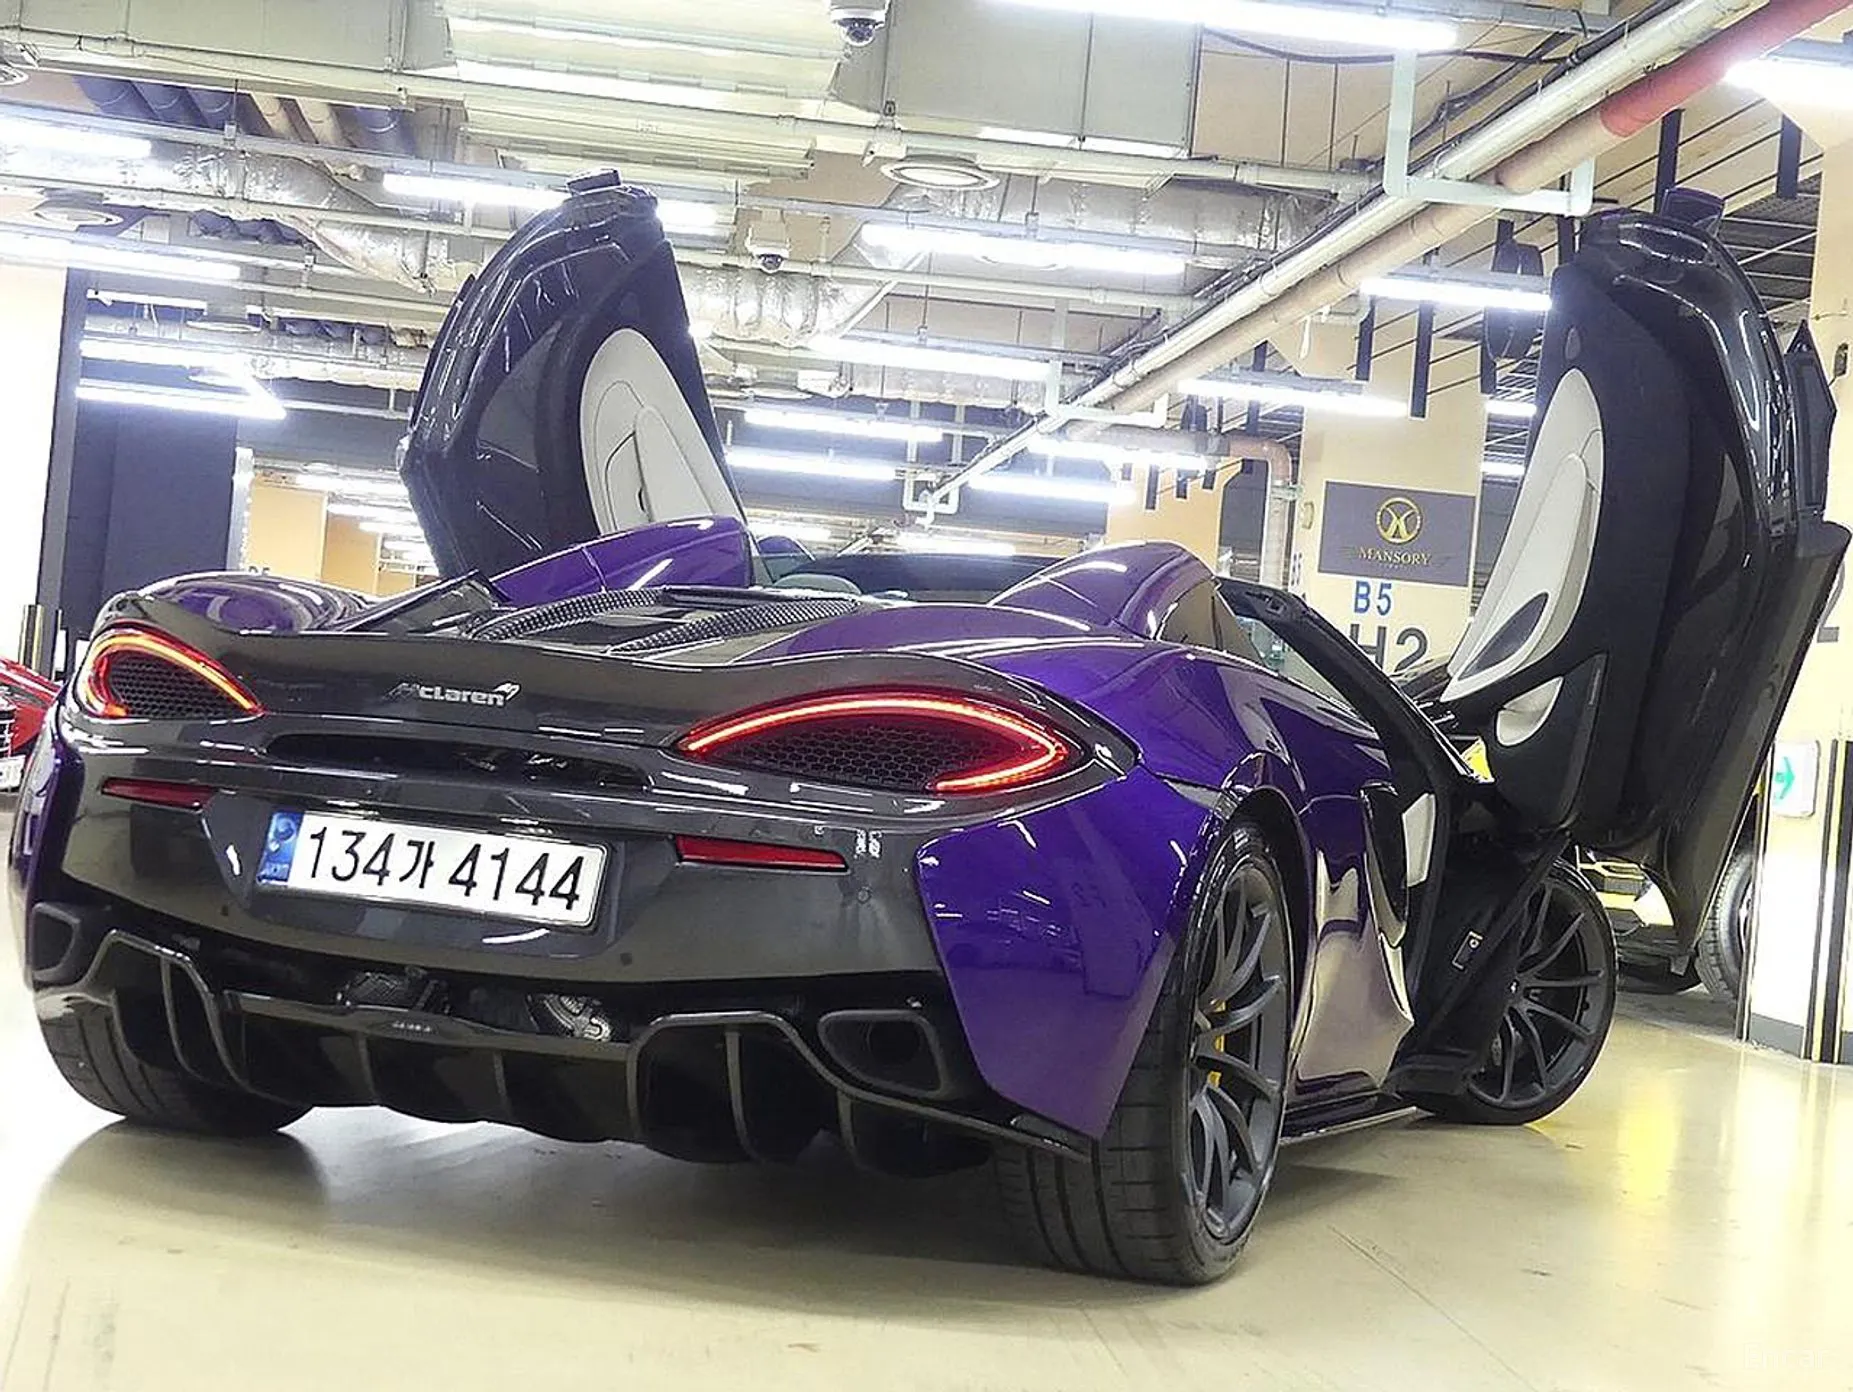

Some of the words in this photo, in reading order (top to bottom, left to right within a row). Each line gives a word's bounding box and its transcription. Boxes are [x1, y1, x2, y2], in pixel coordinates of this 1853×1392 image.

[1358, 546, 1432, 566] MANSORY
[1353, 580, 1392, 616] B5
[1349, 623, 1428, 674] H2
[310, 826, 435, 889] 134가
[448, 843, 585, 910] 4144
